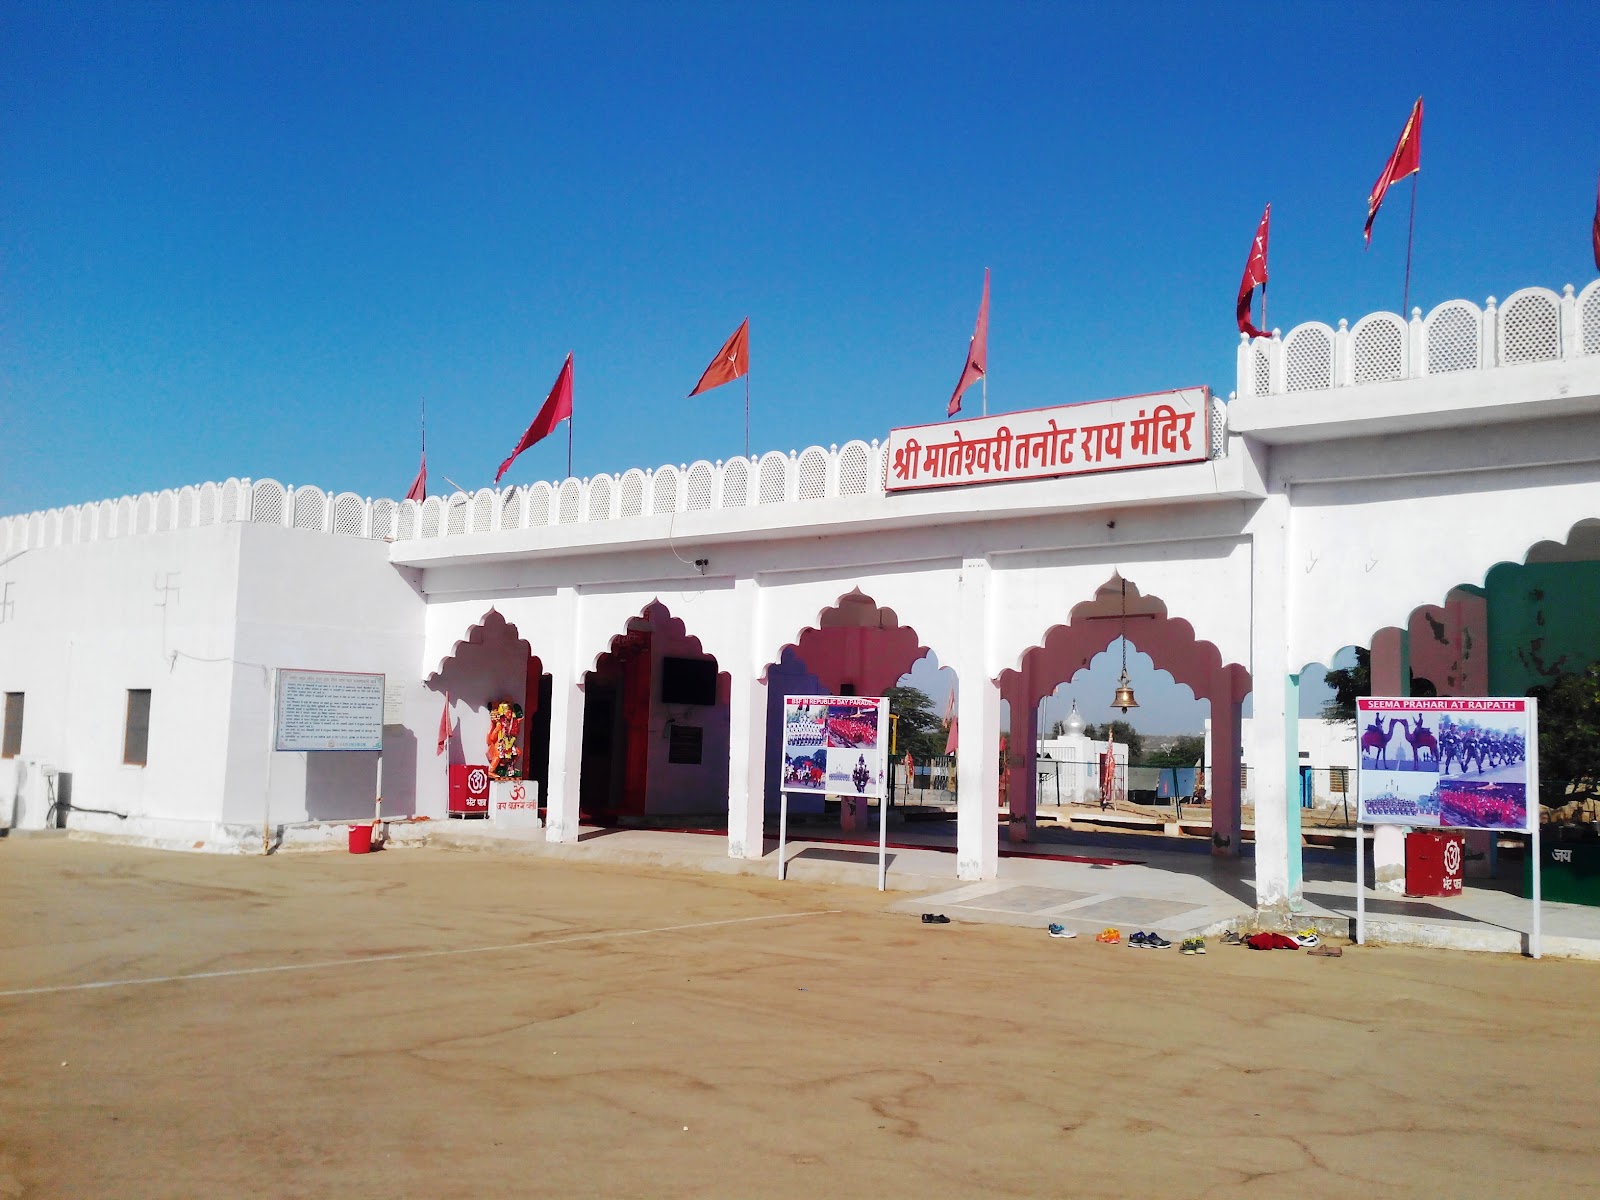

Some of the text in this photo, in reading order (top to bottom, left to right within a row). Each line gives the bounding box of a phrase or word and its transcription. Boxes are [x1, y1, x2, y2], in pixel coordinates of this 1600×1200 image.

[892, 404, 1196, 480] श्री मातेश्वरी तनोट राय मंदिर
[1368, 701, 1401, 709] SEEMA
[1403, 701, 1448, 709] PRAHARI
[1467, 702, 1516, 710] RAJPATH
[1552, 848, 1573, 863] जय
